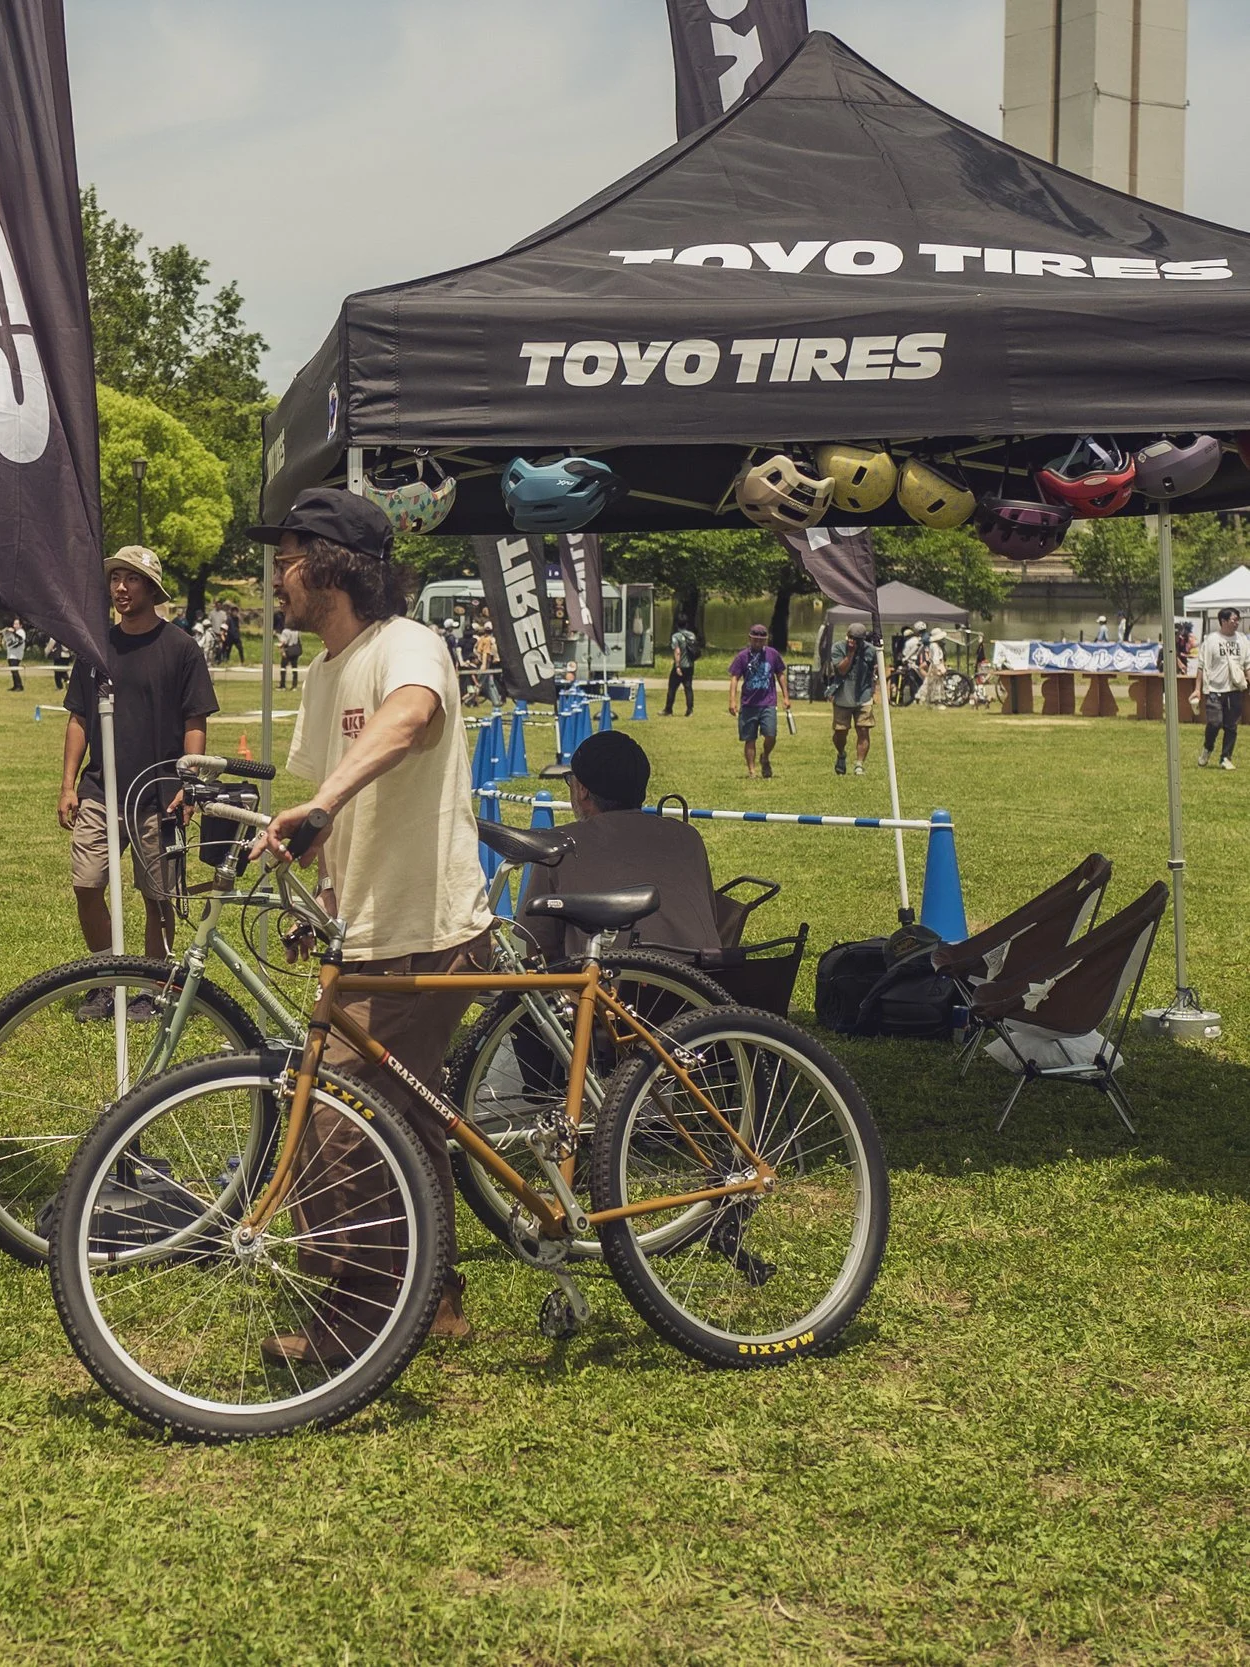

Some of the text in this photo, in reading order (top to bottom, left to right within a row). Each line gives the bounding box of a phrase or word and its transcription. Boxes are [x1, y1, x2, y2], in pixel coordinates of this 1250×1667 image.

[919, 243, 1233, 281] TIRES
[519, 332, 948, 388] TOYO TIRES
[738, 1330, 815, 1355] MAXXIS
